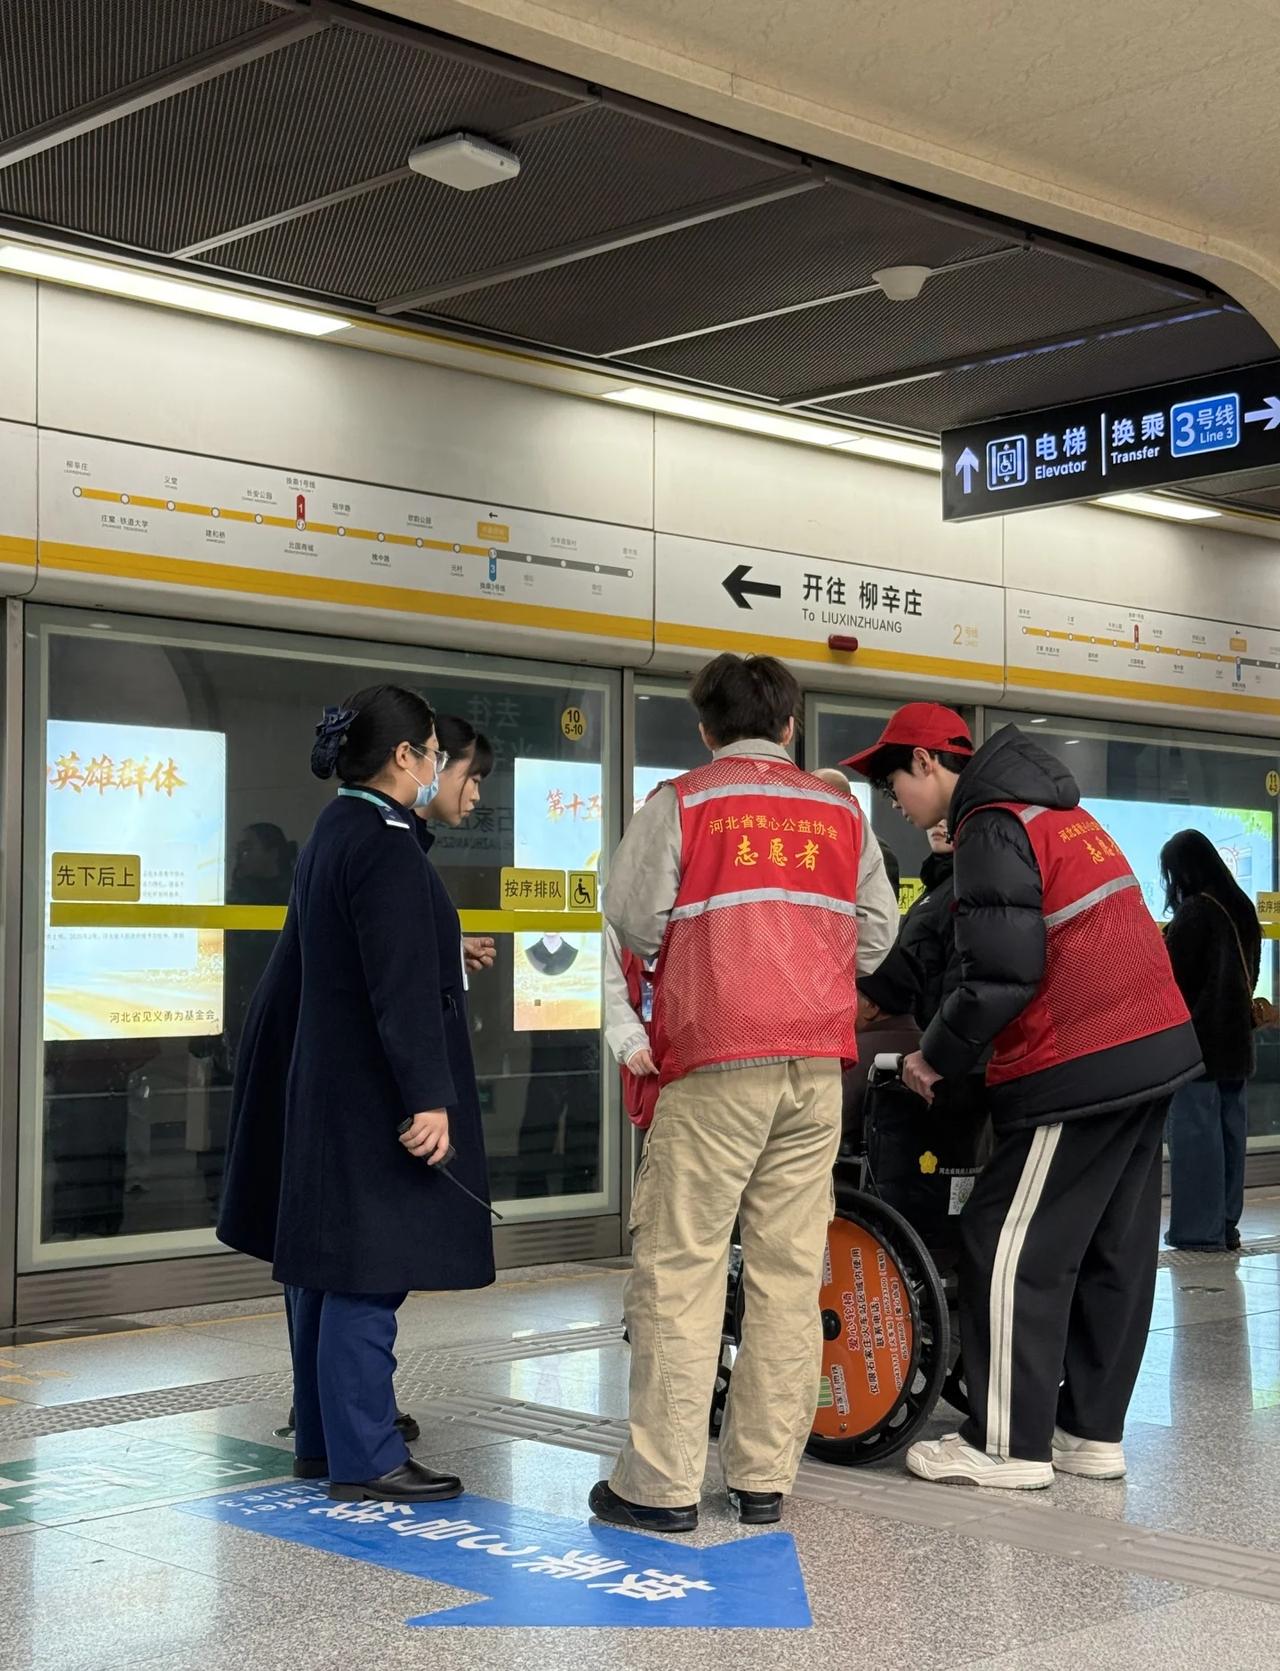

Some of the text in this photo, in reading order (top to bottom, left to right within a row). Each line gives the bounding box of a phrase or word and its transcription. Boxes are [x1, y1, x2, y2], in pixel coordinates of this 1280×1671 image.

[1111, 412, 1165, 447] 换乘
[1199, 427, 1234, 446] Line 3
[1035, 425, 1087, 462] 电梯
[1110, 446, 1160, 466] Transfer
[1034, 458, 1088, 482] Elevator
[802, 573, 923, 617] 开往 柳辛庄
[802, 608, 903, 633] To LIUXINZHUANG
[567, 710, 580, 723] 10
[565, 724, 583, 735] 5-10
[50, 751, 188, 798] 英雄群体
[709, 814, 839, 840] 河北省爱心公益协会
[734, 834, 820, 872] 志愿者
[56, 865, 135, 887] 先下后上
[504, 880, 562, 898] 按序排队
[109, 1009, 216, 1024] 河北省见义勇为基金会
[842, 1291, 860, 1351] 爱心轮椅
[851, 1248, 880, 1395] 仅限石家庄火车站区域内使用
[239, 1493, 328, 1516] nsfer
[242, 1485, 320, 1503] Line
[308, 1500, 717, 1602] 换乘3号线
